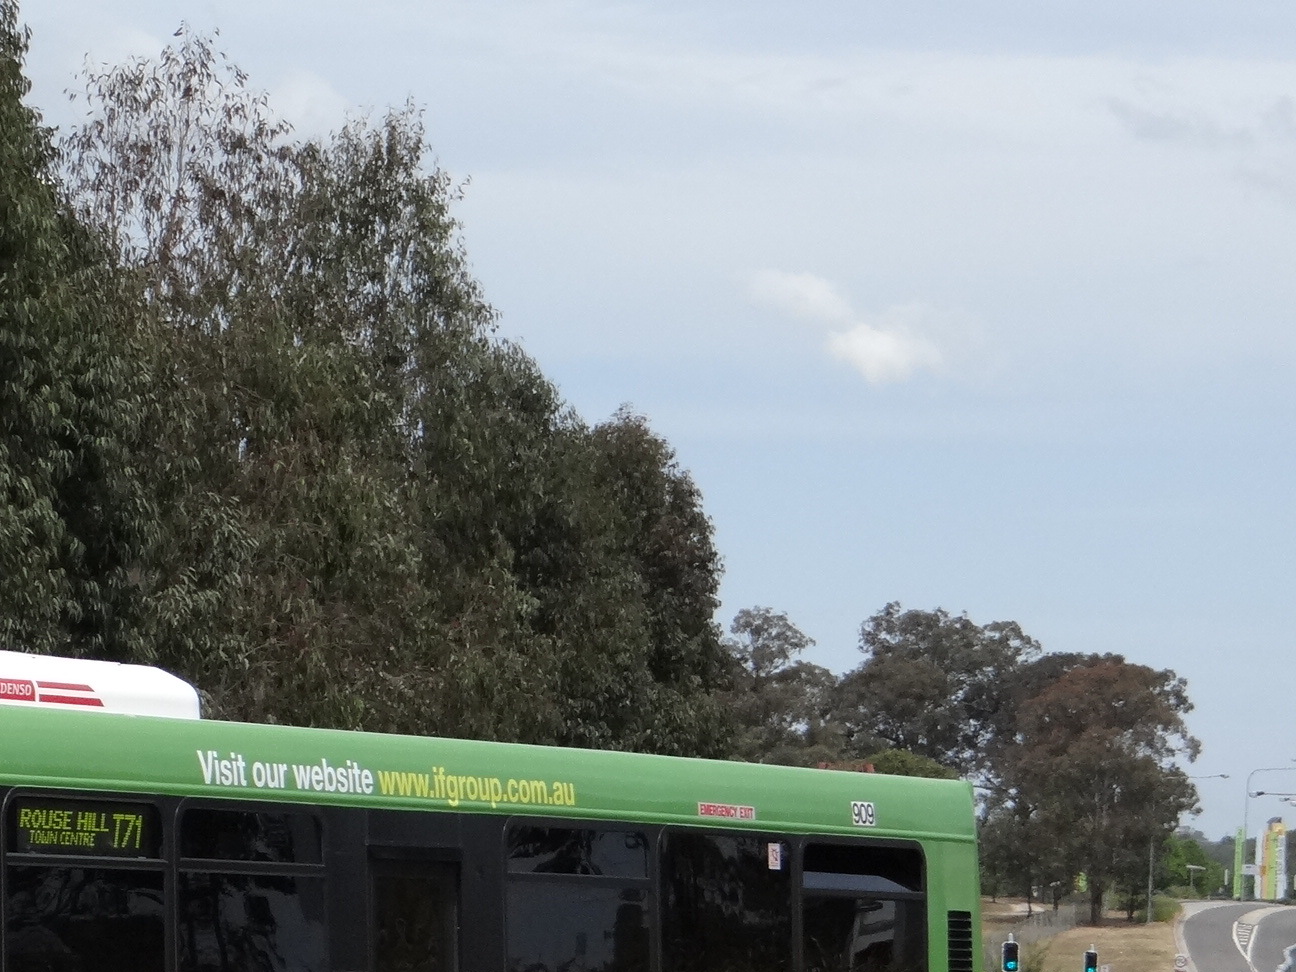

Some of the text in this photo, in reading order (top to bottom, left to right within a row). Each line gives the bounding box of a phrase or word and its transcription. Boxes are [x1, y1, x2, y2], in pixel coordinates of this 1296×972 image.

[0, 681, 32, 696] DENSO
[196, 749, 576, 809] Visit our website www.ifgroup.com.au
[700, 803, 754, 819] EMERGENCY EXIT
[853, 803, 874, 824] 909
[19, 808, 144, 849] ROUSE HILL T71
[29, 829, 96, 847] TOWN CENTRE
